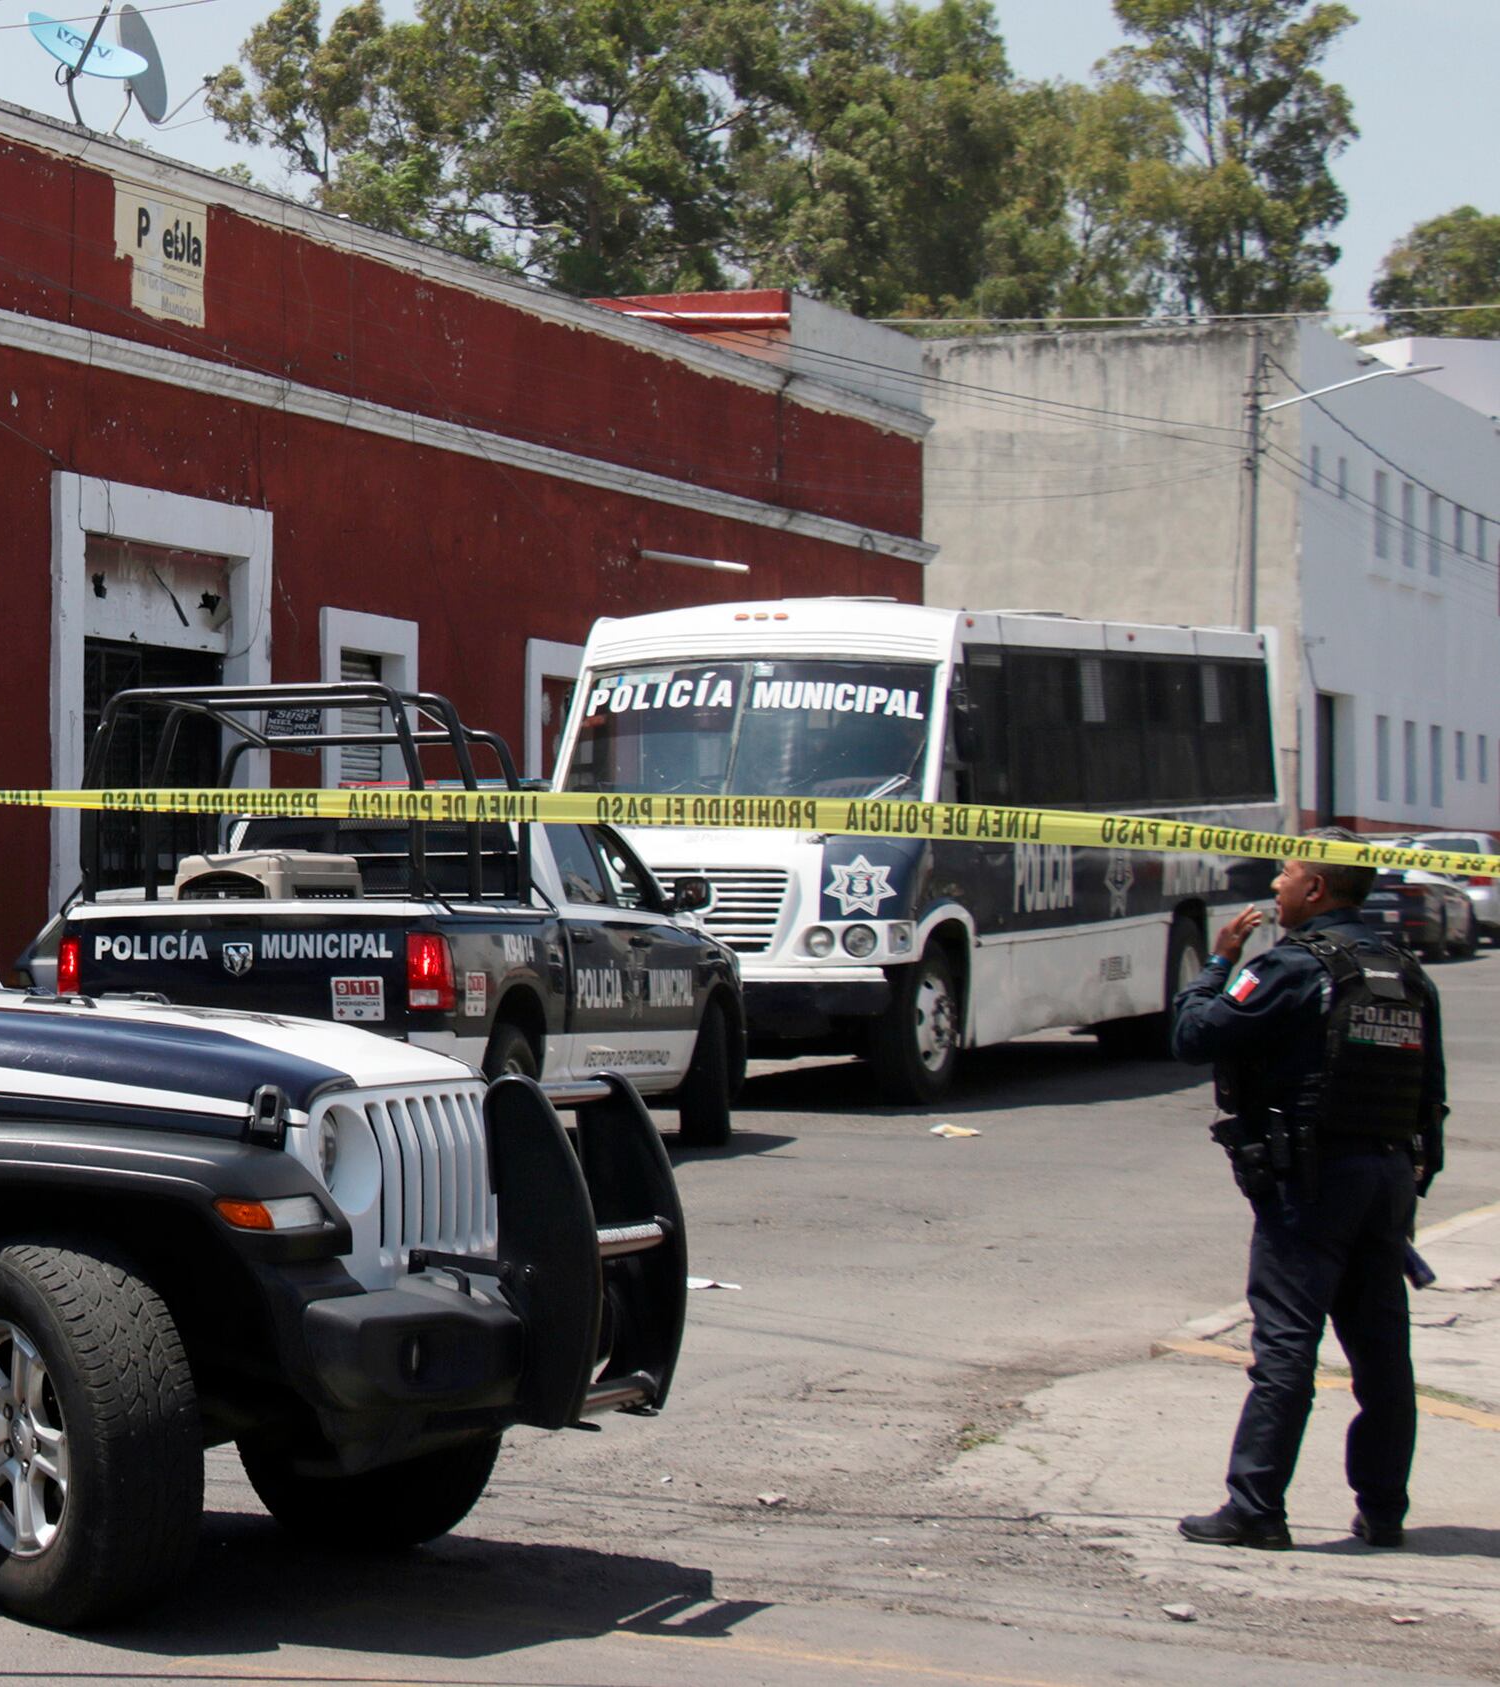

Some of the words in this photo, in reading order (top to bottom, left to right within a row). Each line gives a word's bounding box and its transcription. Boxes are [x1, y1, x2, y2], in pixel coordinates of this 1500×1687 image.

[586, 672, 733, 717] POLICÍA
[752, 681, 924, 720] MUNICIPAL
[94, 930, 208, 960] POLICÍA
[261, 933, 394, 959] MUNICIPAL
[335, 981, 378, 995] 911
[577, 960, 624, 1008] POLICÍA
[649, 968, 694, 1007] MUNICIPAL
